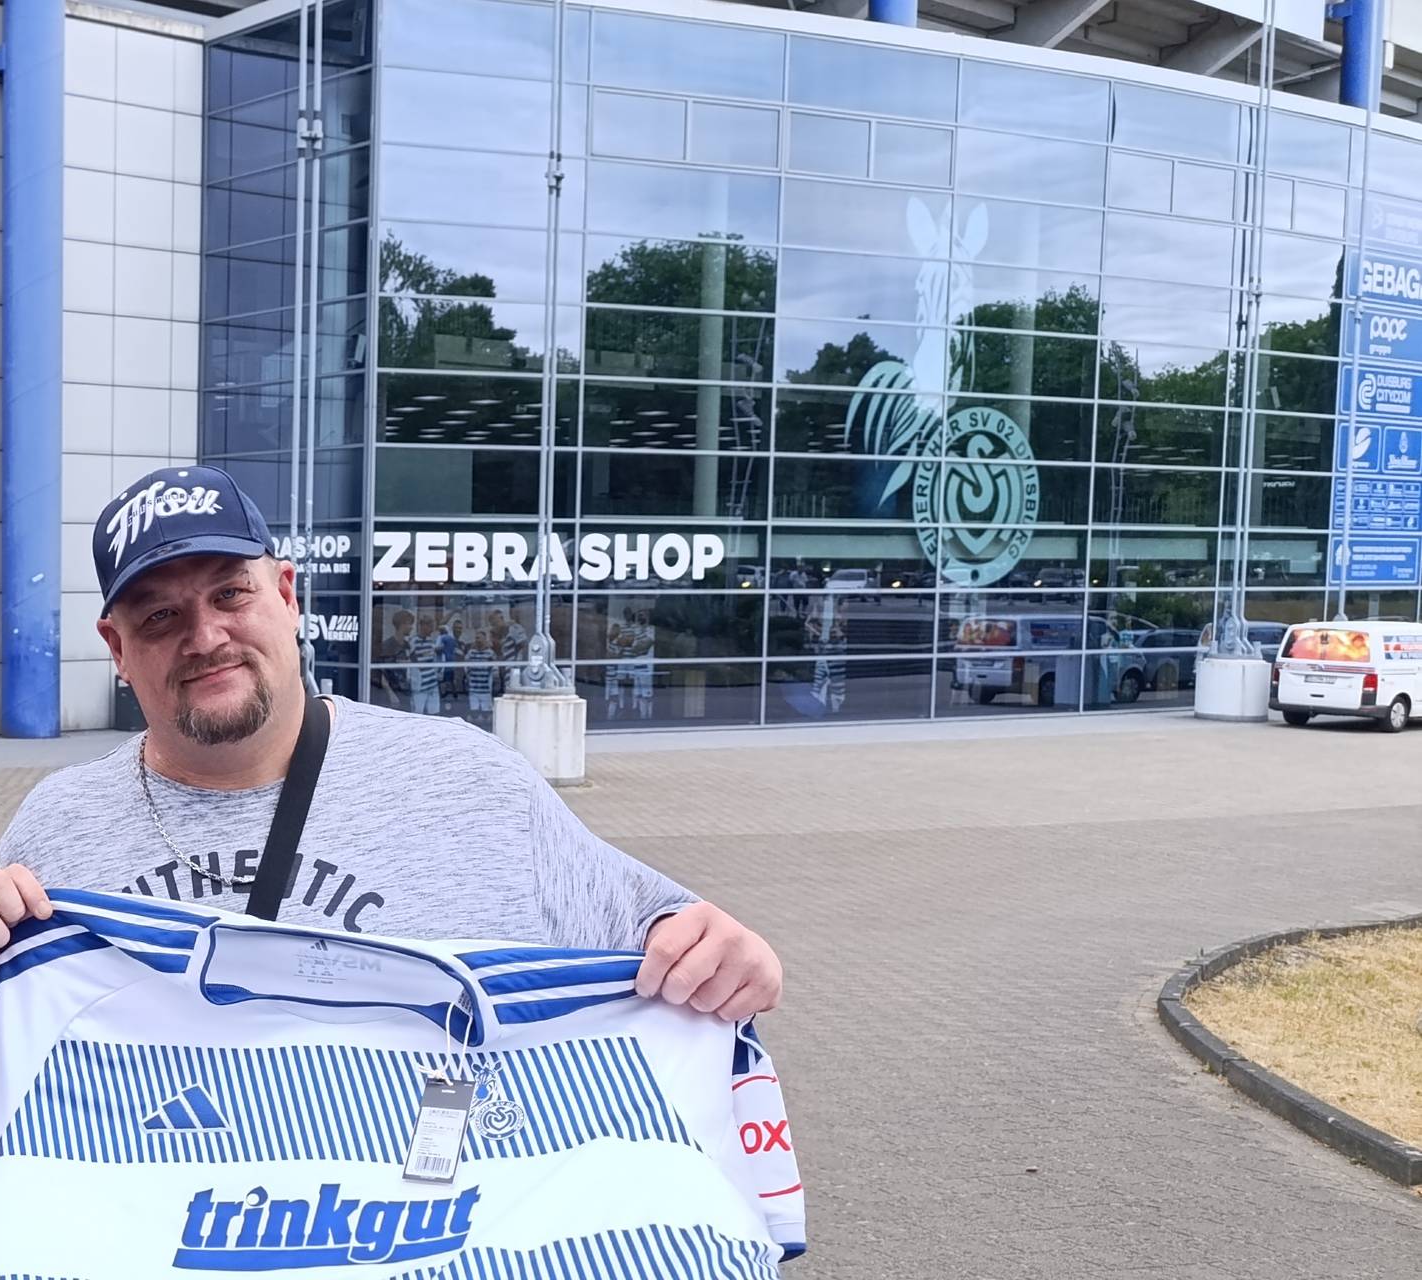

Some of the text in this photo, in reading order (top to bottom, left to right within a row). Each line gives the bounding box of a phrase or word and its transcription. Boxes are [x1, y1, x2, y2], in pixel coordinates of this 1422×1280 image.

[969, 411, 991, 428] SV
[996, 418, 1016, 441] 02
[122, 848, 385, 934] THETIC
[180, 1183, 482, 1263] trinkgut
